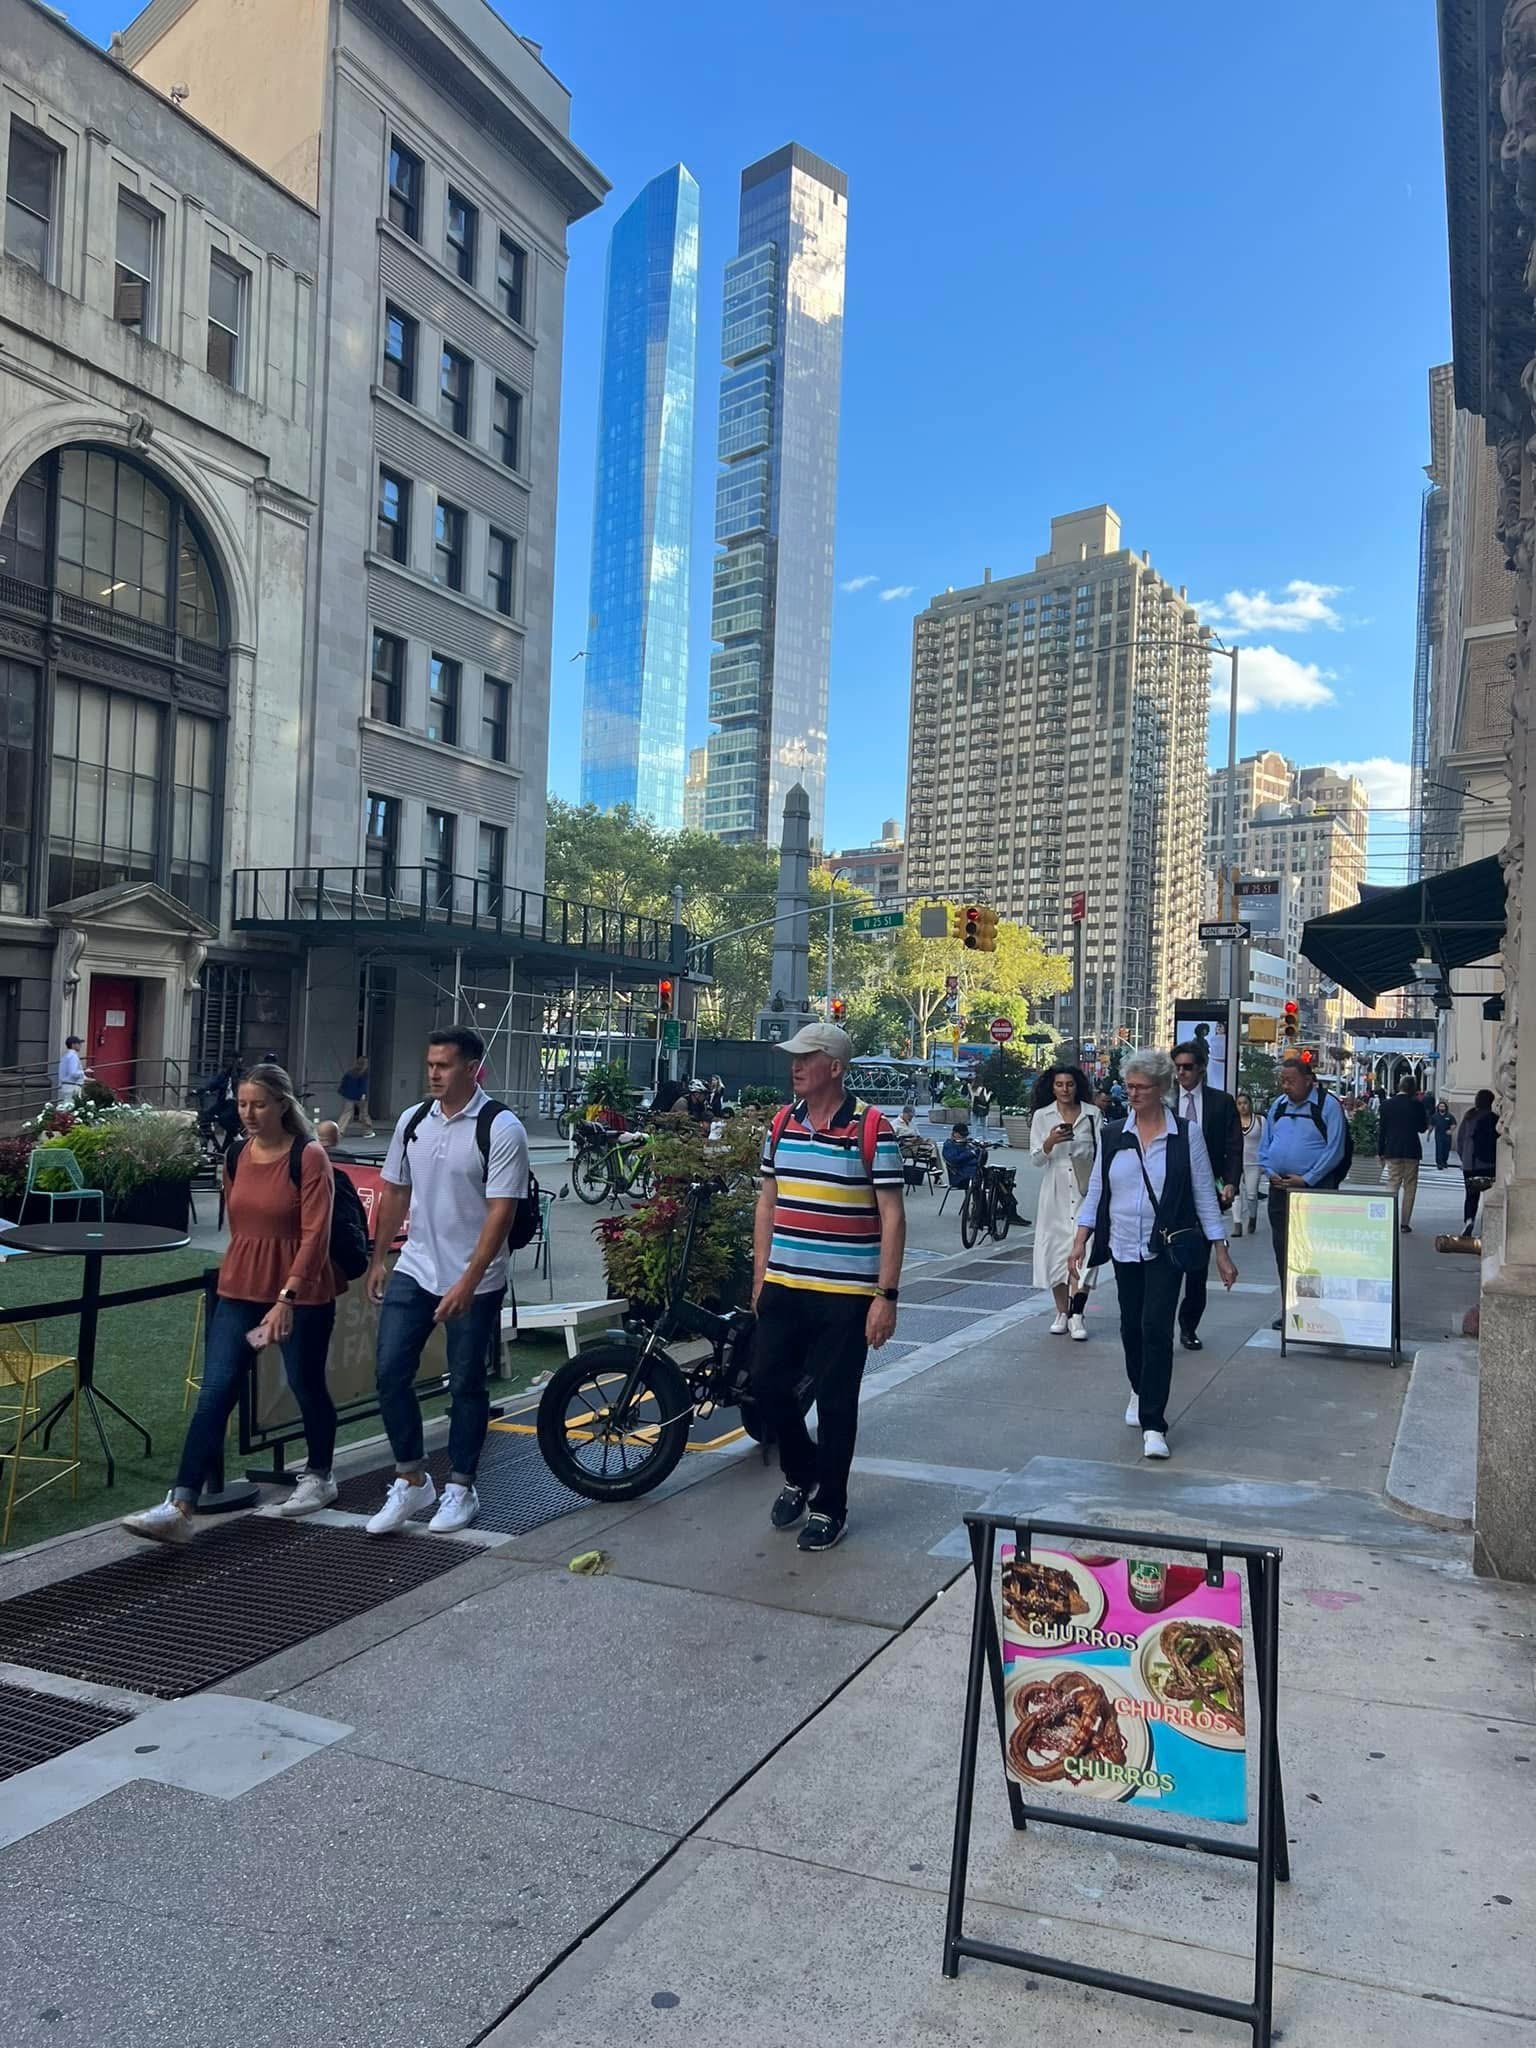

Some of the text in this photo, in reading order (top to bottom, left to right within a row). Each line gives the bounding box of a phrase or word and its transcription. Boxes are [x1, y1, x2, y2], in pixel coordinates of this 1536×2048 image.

[1242, 885, 1250, 894] W
[1252, 884, 1261, 894] 25
[863, 915, 892, 929] W 25 St
[1205, 926, 1244, 936] ONE WAY
[1029, 1620, 1138, 1651] CHURROS
[1114, 1696, 1230, 1731] CHURROS
[1063, 1756, 1176, 1792] CHURROS
